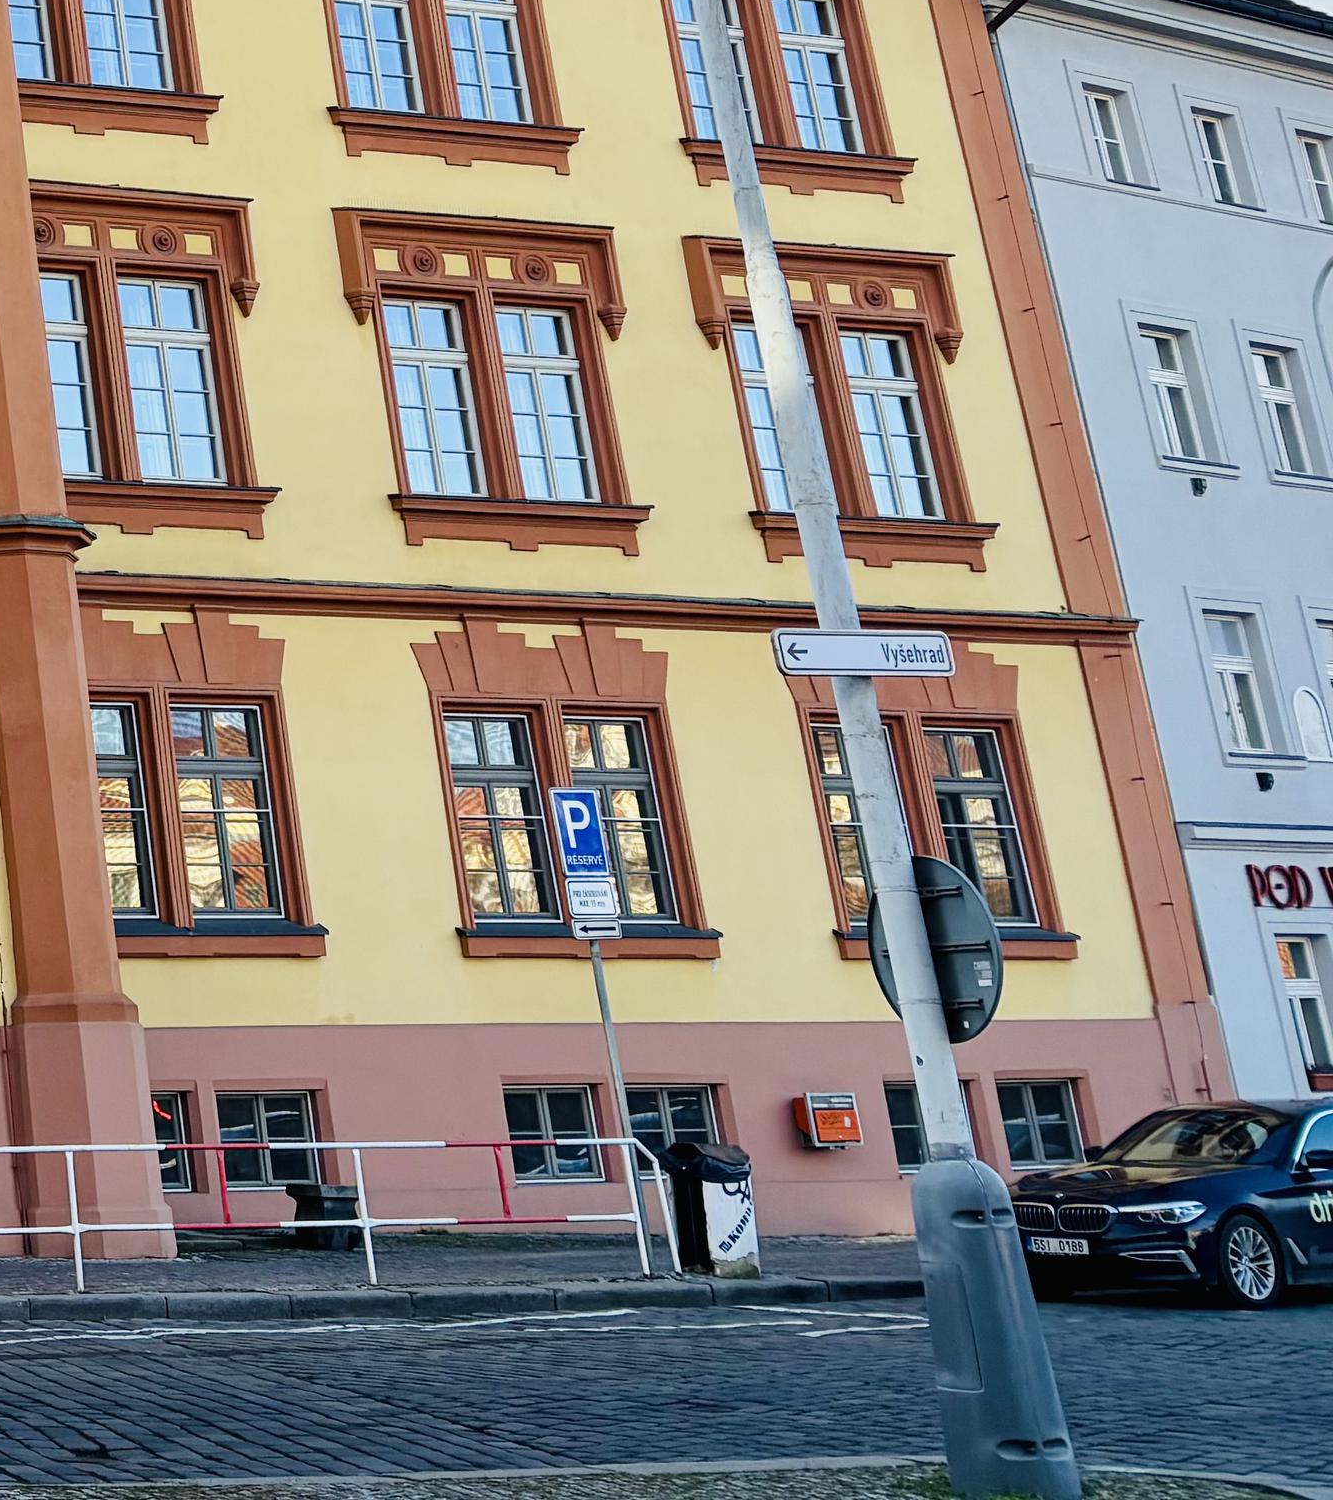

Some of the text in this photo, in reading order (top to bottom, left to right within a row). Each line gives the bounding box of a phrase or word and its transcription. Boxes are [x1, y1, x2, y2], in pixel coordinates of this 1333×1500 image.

[880, 643, 945, 668] Vyšehrad
[562, 800, 590, 849] P
[567, 853, 605, 866] RÉSERVÉ
[1245, 864, 1314, 910] POD
[1058, 1240, 1084, 1252] 0188
